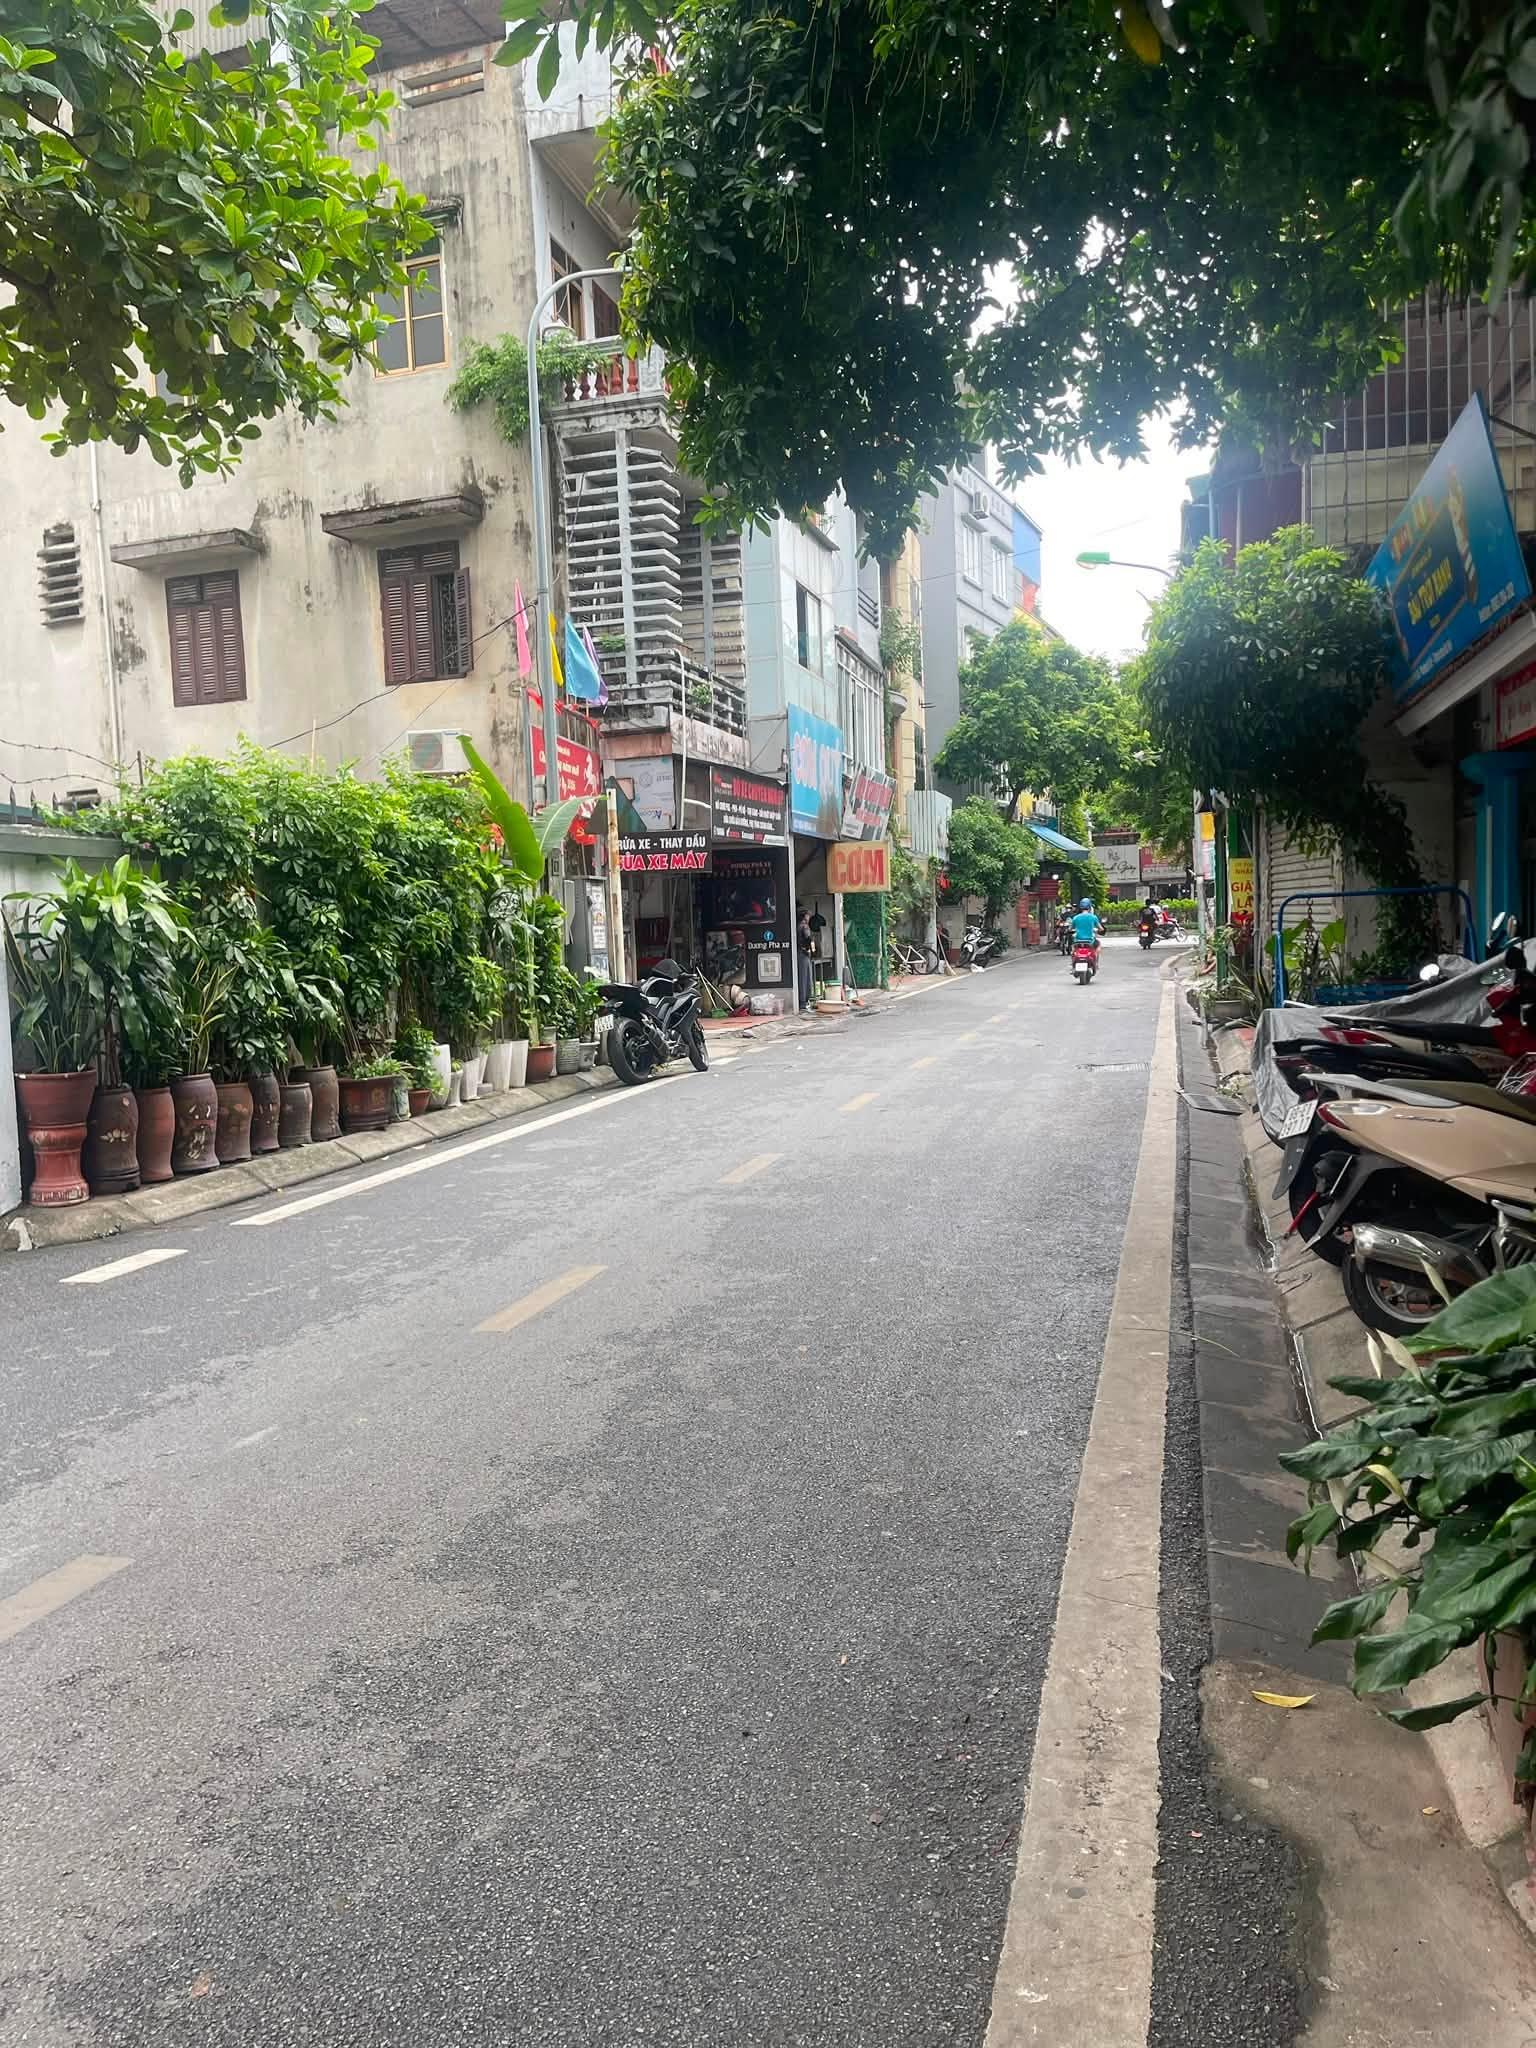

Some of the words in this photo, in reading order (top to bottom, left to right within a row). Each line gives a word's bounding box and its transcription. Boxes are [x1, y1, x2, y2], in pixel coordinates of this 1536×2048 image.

[638, 838, 651, 850] XE
[660, 836, 683, 849] THAY
[647, 853, 668, 870] XE
[831, 846, 885, 887] CƠM
